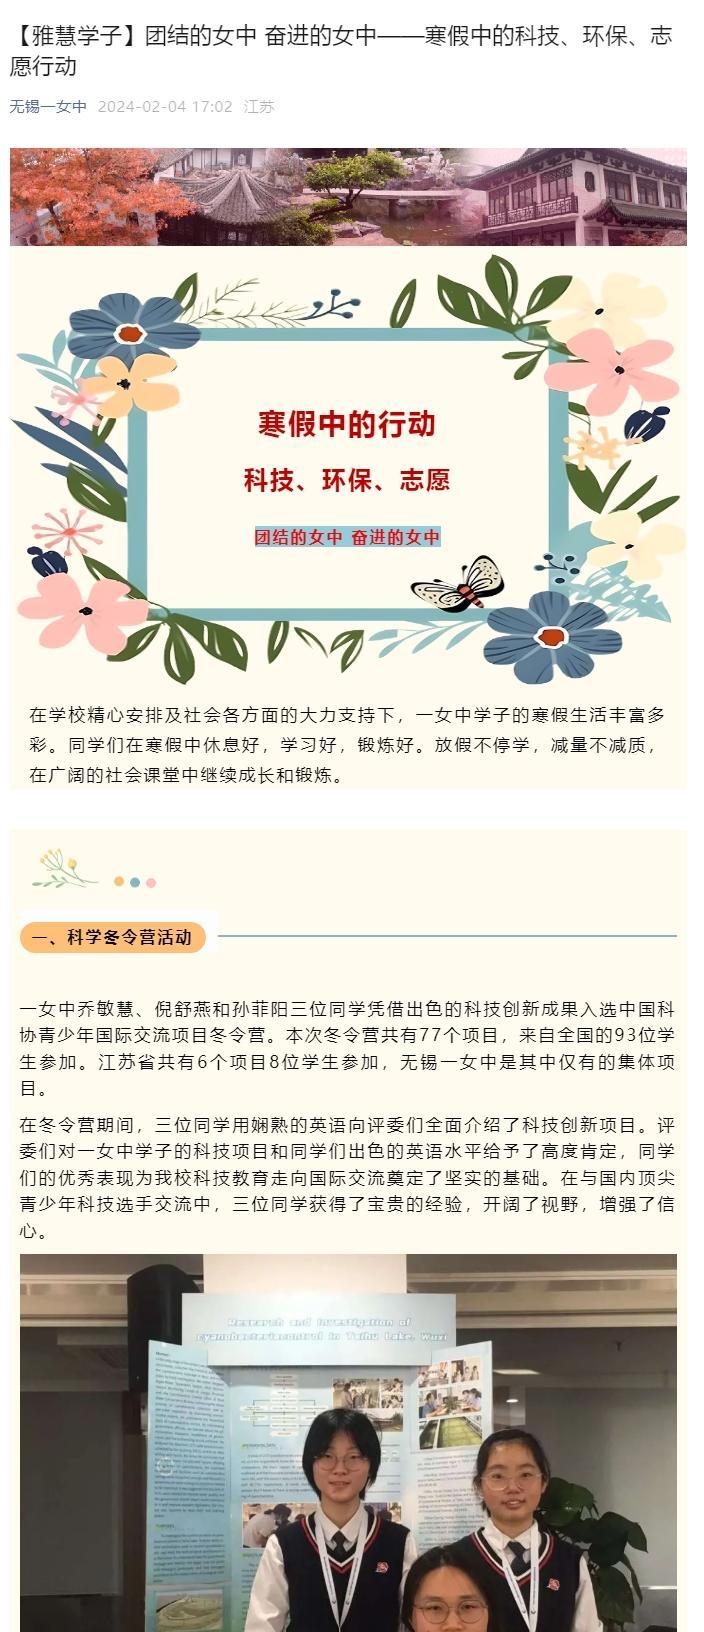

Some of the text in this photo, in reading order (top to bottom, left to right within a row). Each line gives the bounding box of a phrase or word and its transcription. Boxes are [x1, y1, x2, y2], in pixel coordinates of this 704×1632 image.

[10, 54, 76, 77] 愿行动
[9, 99, 276, 115] 无锡一女中 2024-02-04 17:02 江苏
[259, 410, 435, 438] 寒假中的行动
[244, 468, 450, 492] 科技、环保、志愿
[255, 529, 441, 546] 团结的女中 奋进的女中
[32, 929, 191, 945] 一、科学冬令营活动
